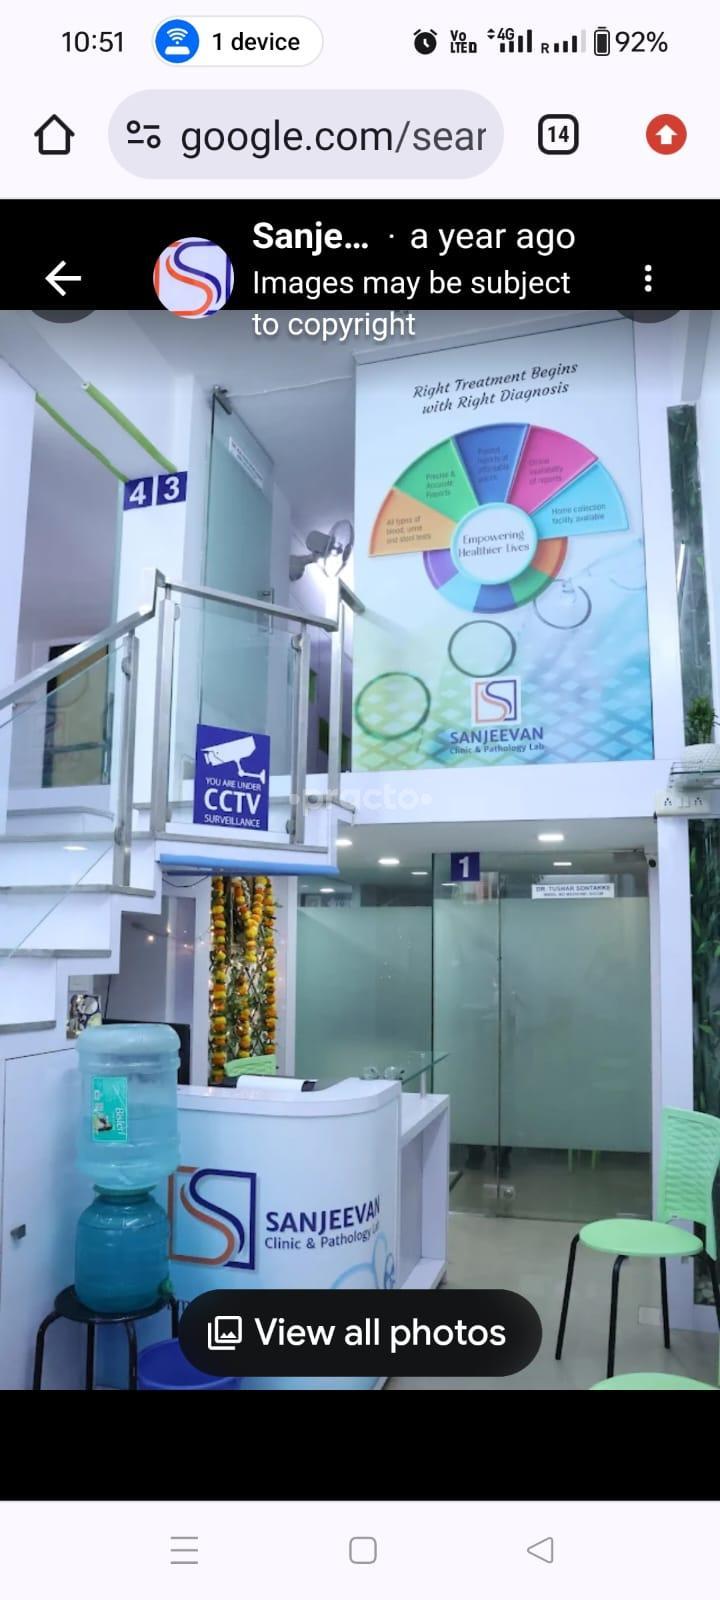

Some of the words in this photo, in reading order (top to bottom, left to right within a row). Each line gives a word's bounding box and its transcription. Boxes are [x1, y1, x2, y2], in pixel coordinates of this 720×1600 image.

[61, 30, 125, 54] 10:51
[212, 32, 224, 51] 1
[230, 31, 301, 52] device
[497, 27, 515, 41] 4G
[614, 30, 669, 54] 92%
[181, 119, 488, 160] google.com/sear
[547, 125, 570, 143] 14
[410, 227, 429, 250] a
[438, 227, 506, 257] year
[516, 227, 576, 257] ago
[253, 270, 355, 300] Images
[362, 274, 421, 300] may
[429, 270, 463, 295] be
[470, 270, 571, 300] subject
[252, 313, 279, 337] to
[287, 312, 416, 342] copyright
[412, 381, 450, 400] Right
[454, 370, 527, 392] Treatment
[530, 362, 579, 382] Begins
[421, 401, 452, 415] with
[456, 392, 495, 411] Right
[499, 382, 570, 404] Diagnosis
[129, 481, 147, 505] 4
[163, 476, 180, 501] 3
[458, 546, 503, 559] Healthier
[506, 541, 530, 554] Lives
[462, 529, 525, 547] Empowering
[450, 726, 544, 745] SANJEEVAN
[450, 746, 473, 755] Clinic
[484, 743, 527, 753] Pathology
[530, 742, 545, 750] Lab
[205, 777, 221, 786] YOU
[223, 779, 236, 788] ARE
[237, 782, 262, 791] UNDER
[204, 787, 261, 815] CCTV
[204, 813, 261, 828] SURVEILLANCE
[459, 855, 469, 878] 1
[266, 1194, 380, 1235] SANJEEVAN
[265, 1237, 301, 1249] Clinic
[306, 1237, 316, 1249] &
[321, 1229, 371, 1249] Pathology
[254, 1317, 336, 1346] View
[344, 1318, 380, 1346] all
[391, 1318, 506, 1353] photos
